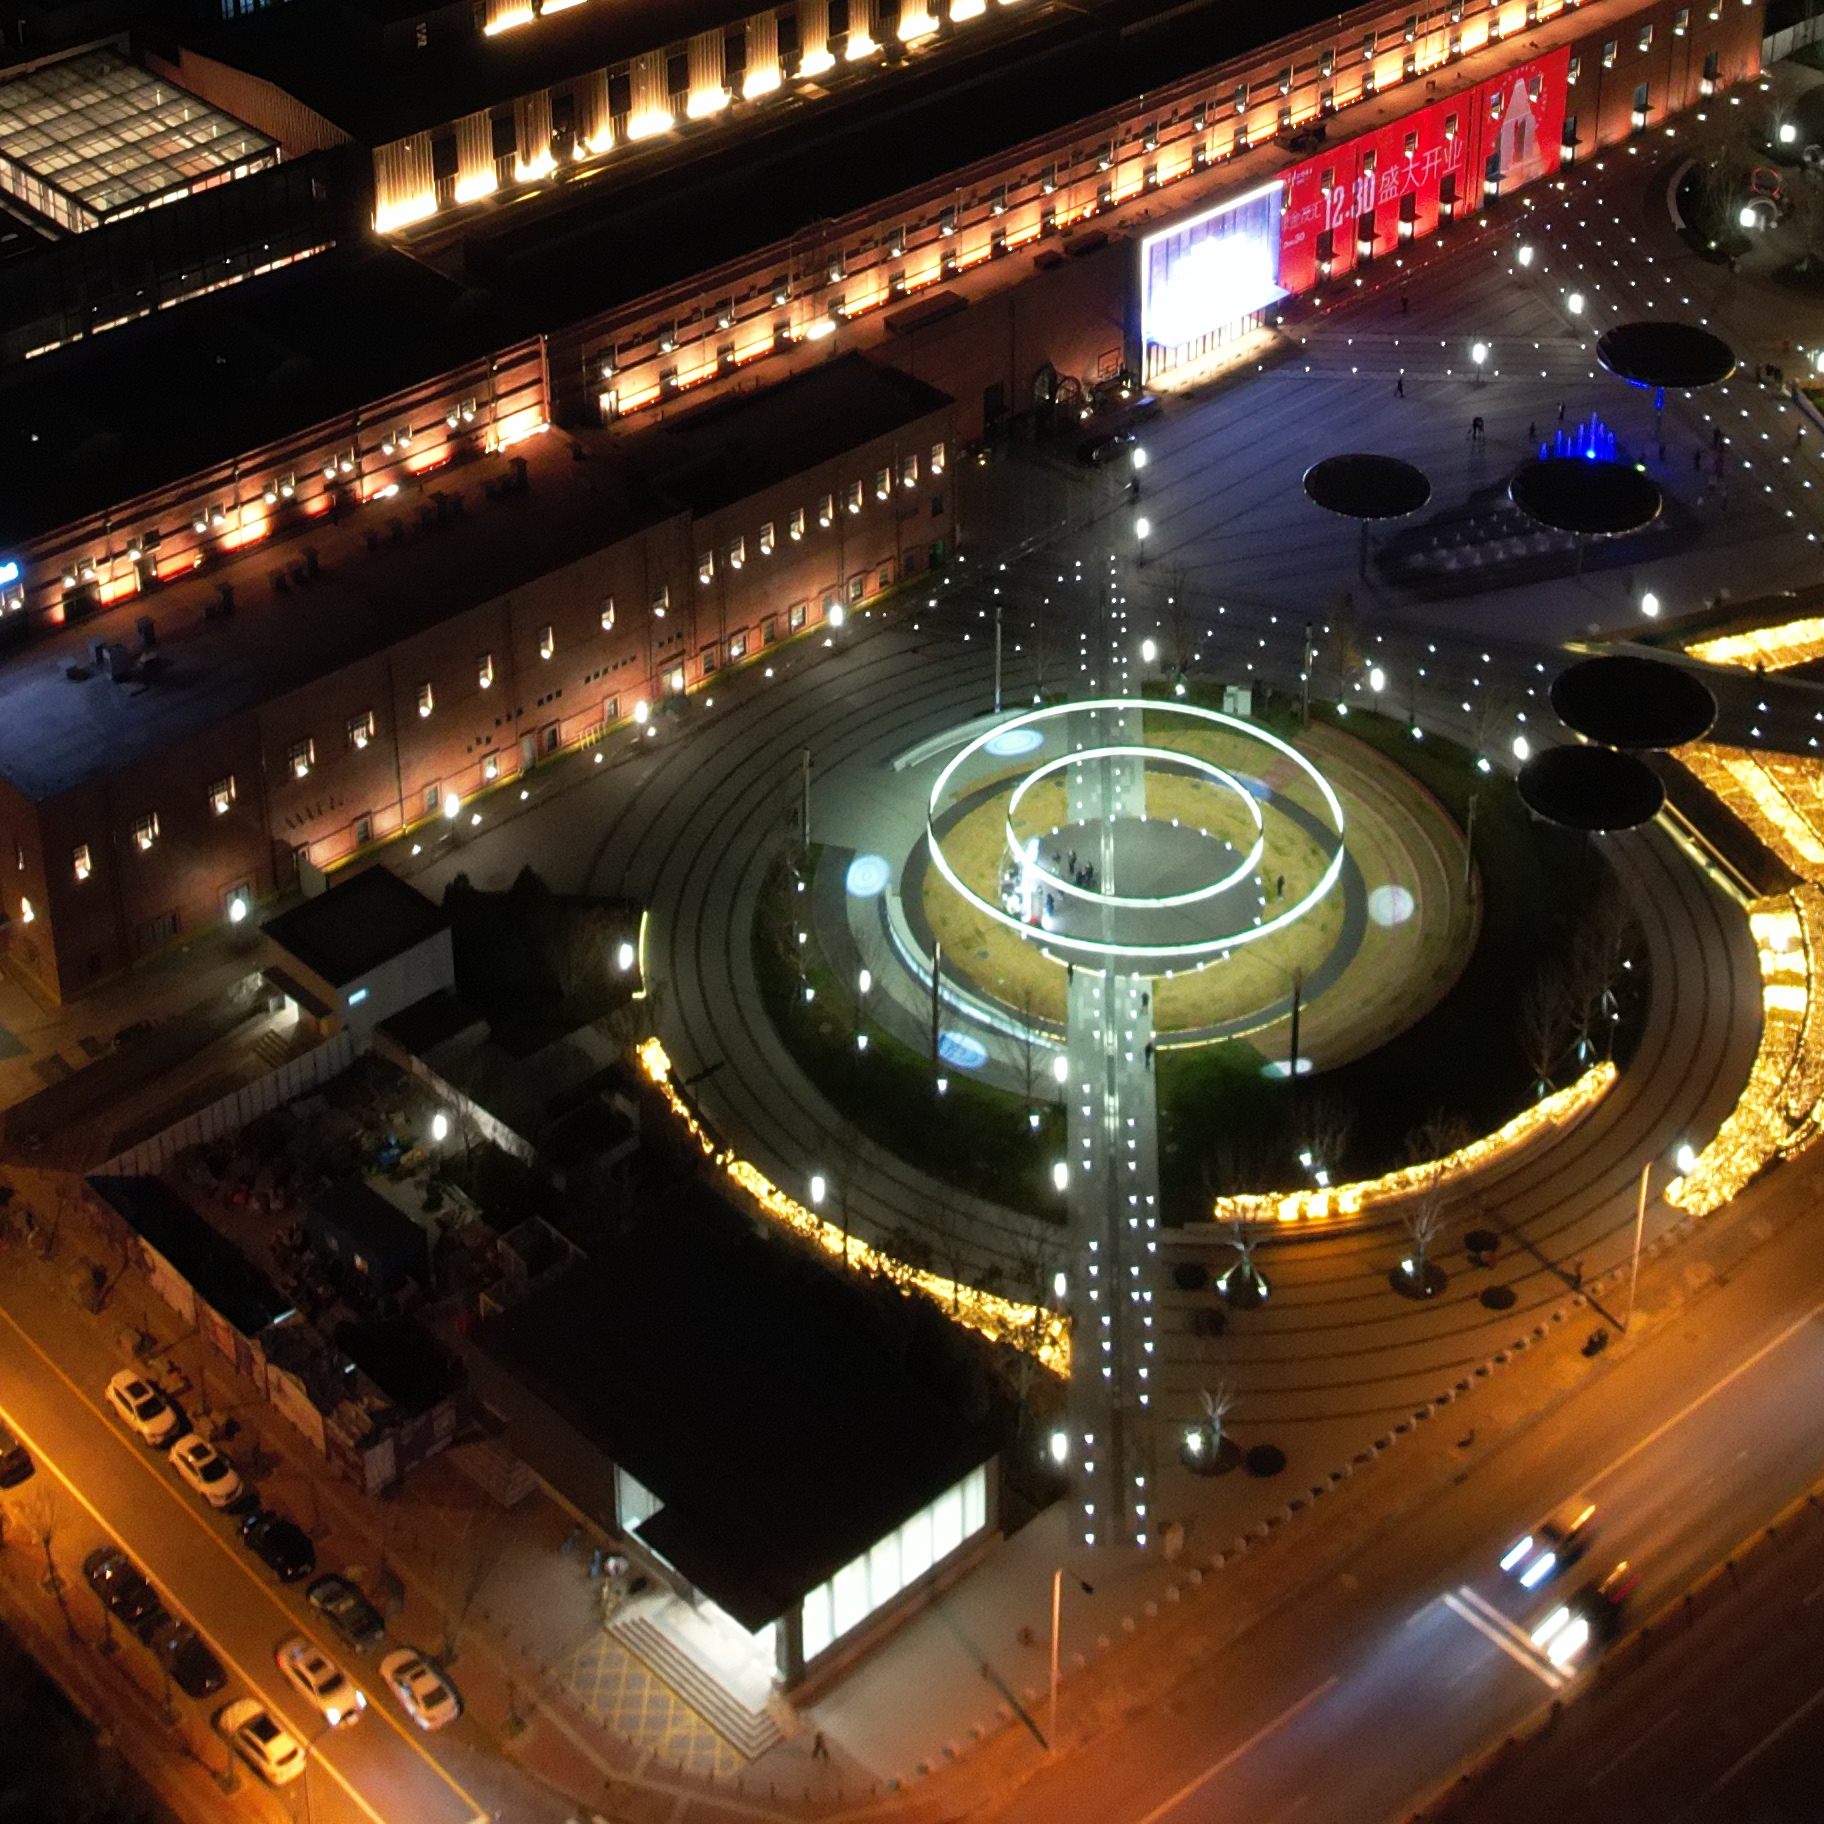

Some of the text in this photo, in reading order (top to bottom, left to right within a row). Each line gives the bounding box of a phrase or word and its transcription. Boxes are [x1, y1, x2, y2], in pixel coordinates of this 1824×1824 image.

[1324, 137, 1464, 231] 12.30 盛大开业
